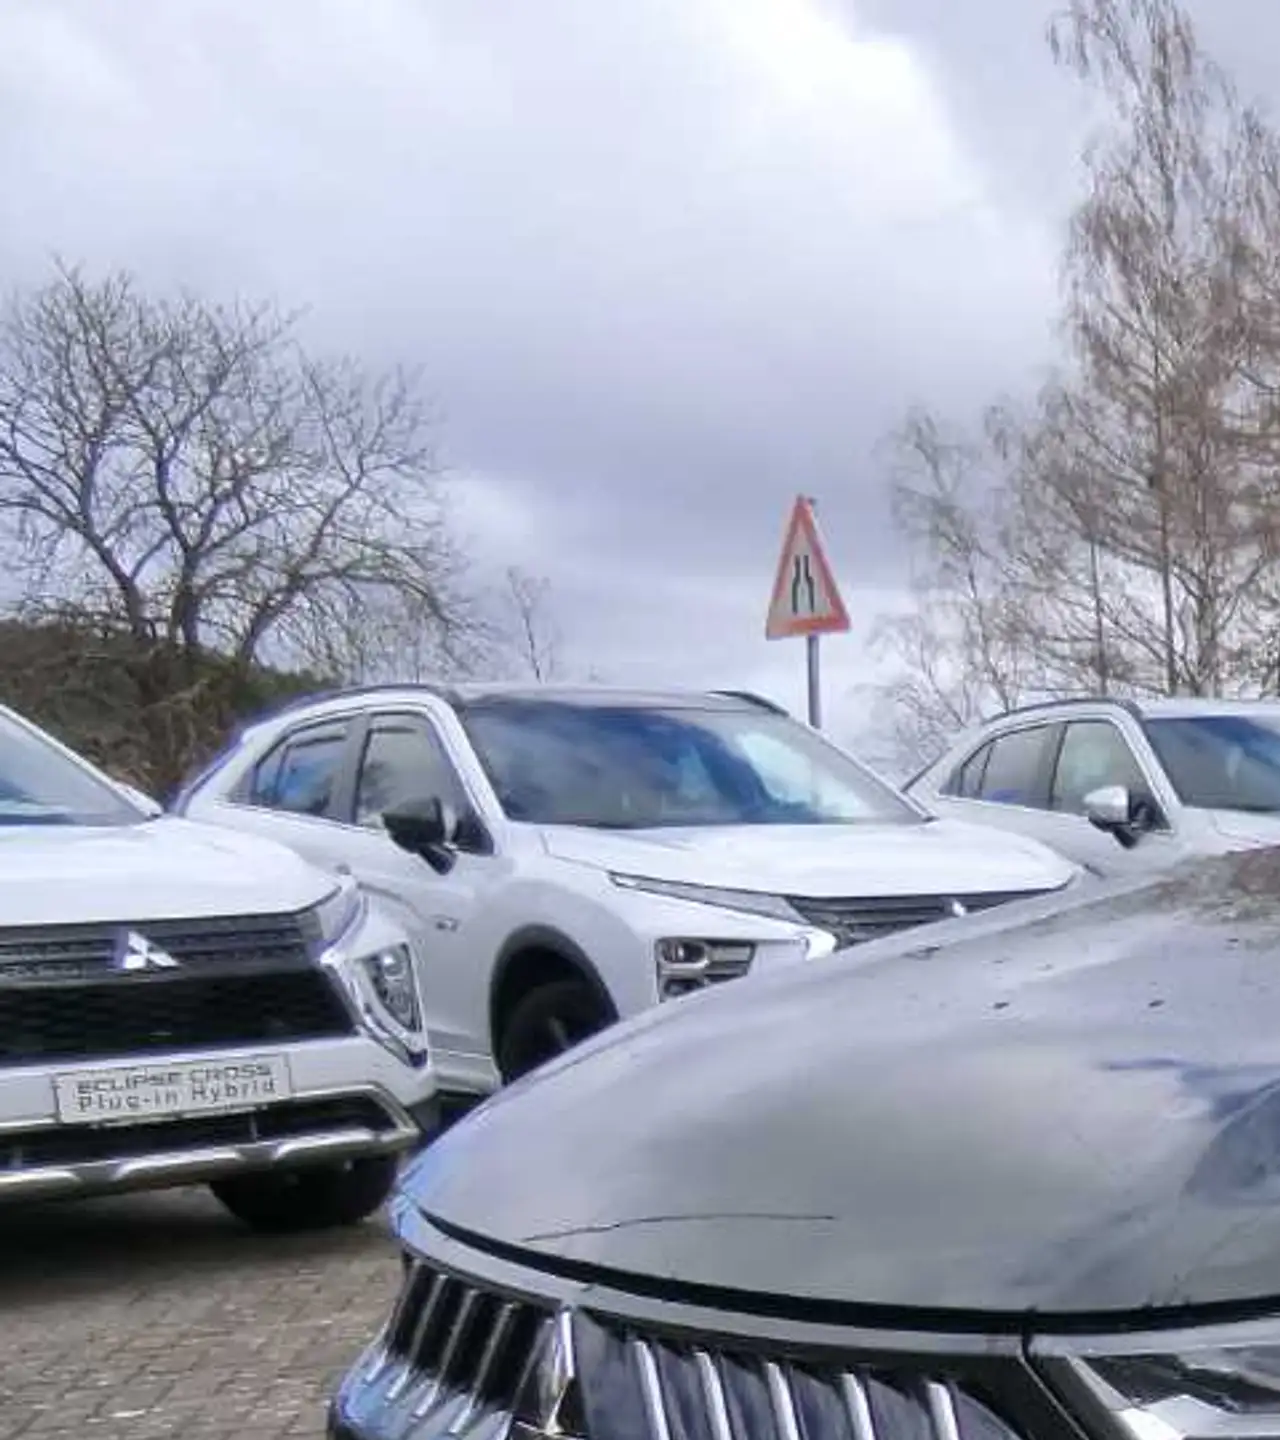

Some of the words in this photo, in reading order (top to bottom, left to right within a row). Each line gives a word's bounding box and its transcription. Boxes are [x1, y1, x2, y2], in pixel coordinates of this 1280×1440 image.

[77, 1071, 182, 1095] ECLIPSE
[190, 1062, 272, 1084] CROSS
[78, 1087, 179, 1112] Plug-in
[191, 1078, 275, 1103] Hybrid
